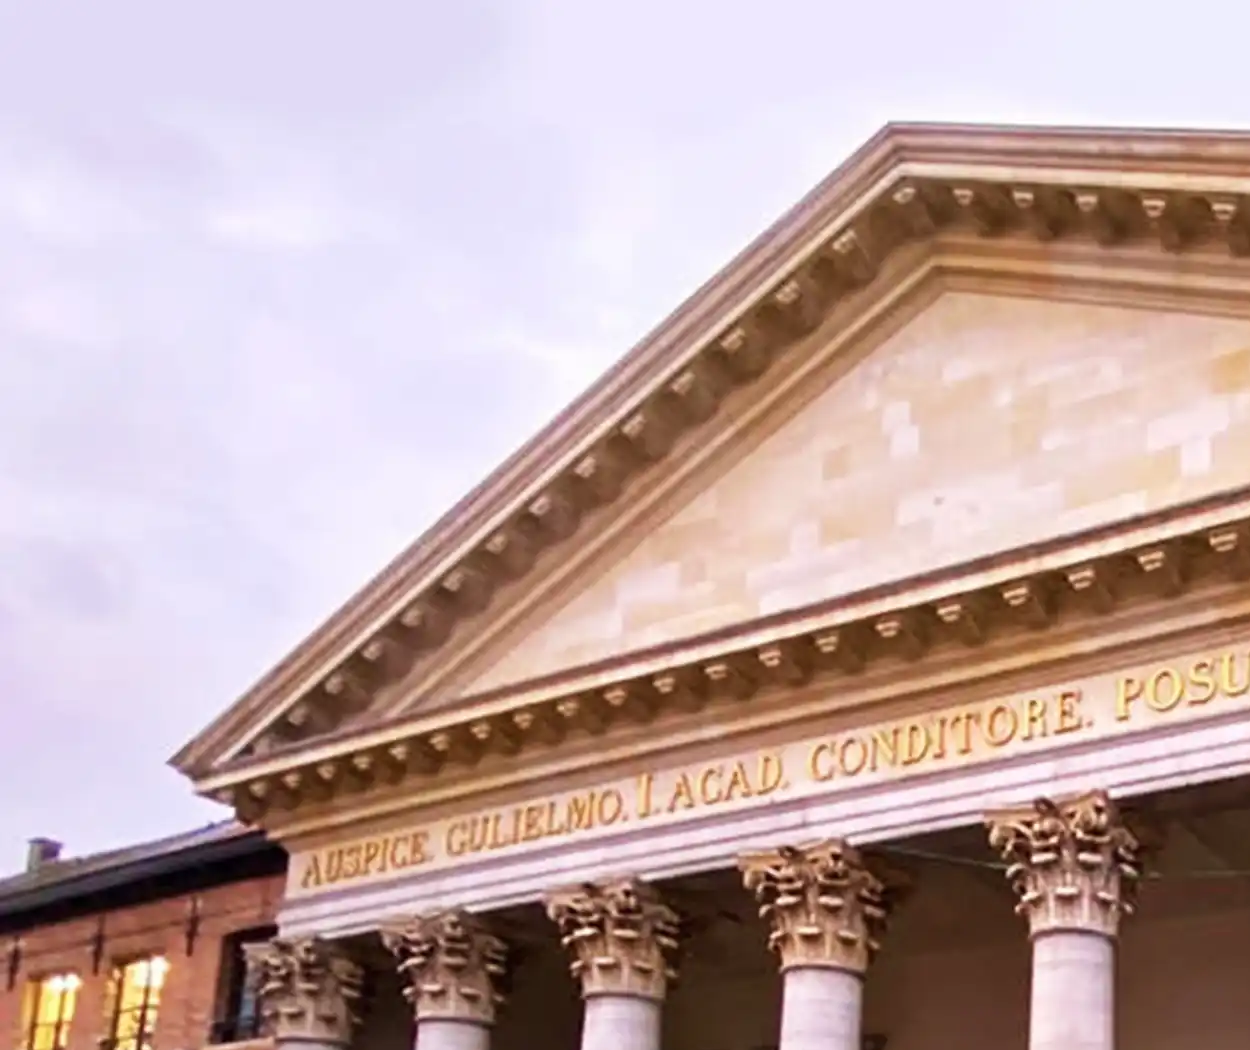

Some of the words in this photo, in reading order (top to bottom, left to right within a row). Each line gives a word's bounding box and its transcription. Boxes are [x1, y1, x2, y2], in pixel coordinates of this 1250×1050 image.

[446, 789, 629, 857] GULIELMO.
[667, 753, 793, 814] ACAD.
[808, 688, 1096, 782] CONDITORE.
